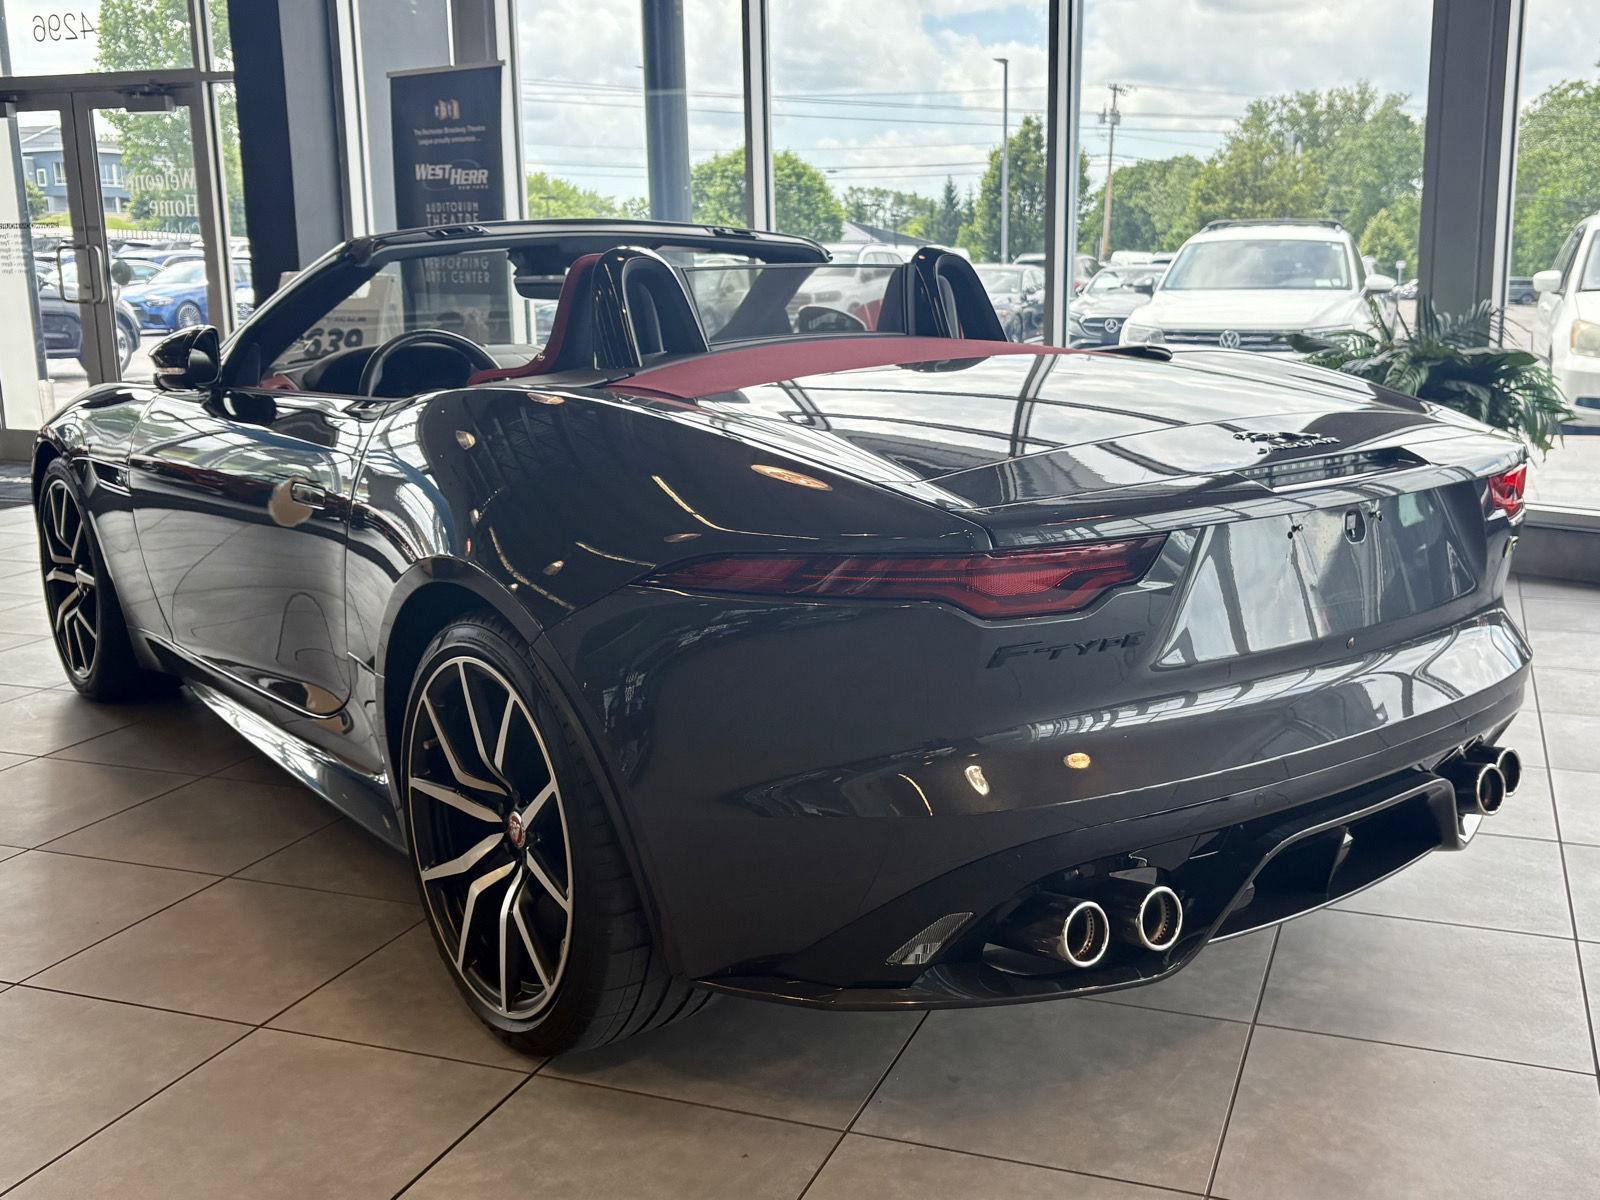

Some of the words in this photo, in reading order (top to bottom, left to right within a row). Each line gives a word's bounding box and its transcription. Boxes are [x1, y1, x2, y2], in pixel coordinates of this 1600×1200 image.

[415, 164, 452, 180] WEST
[450, 168, 488, 185] HERR
[426, 201, 479, 213] AUDITORIUM
[450, 271, 490, 283] CENTER
[985, 631, 1145, 669] F-TYPE
